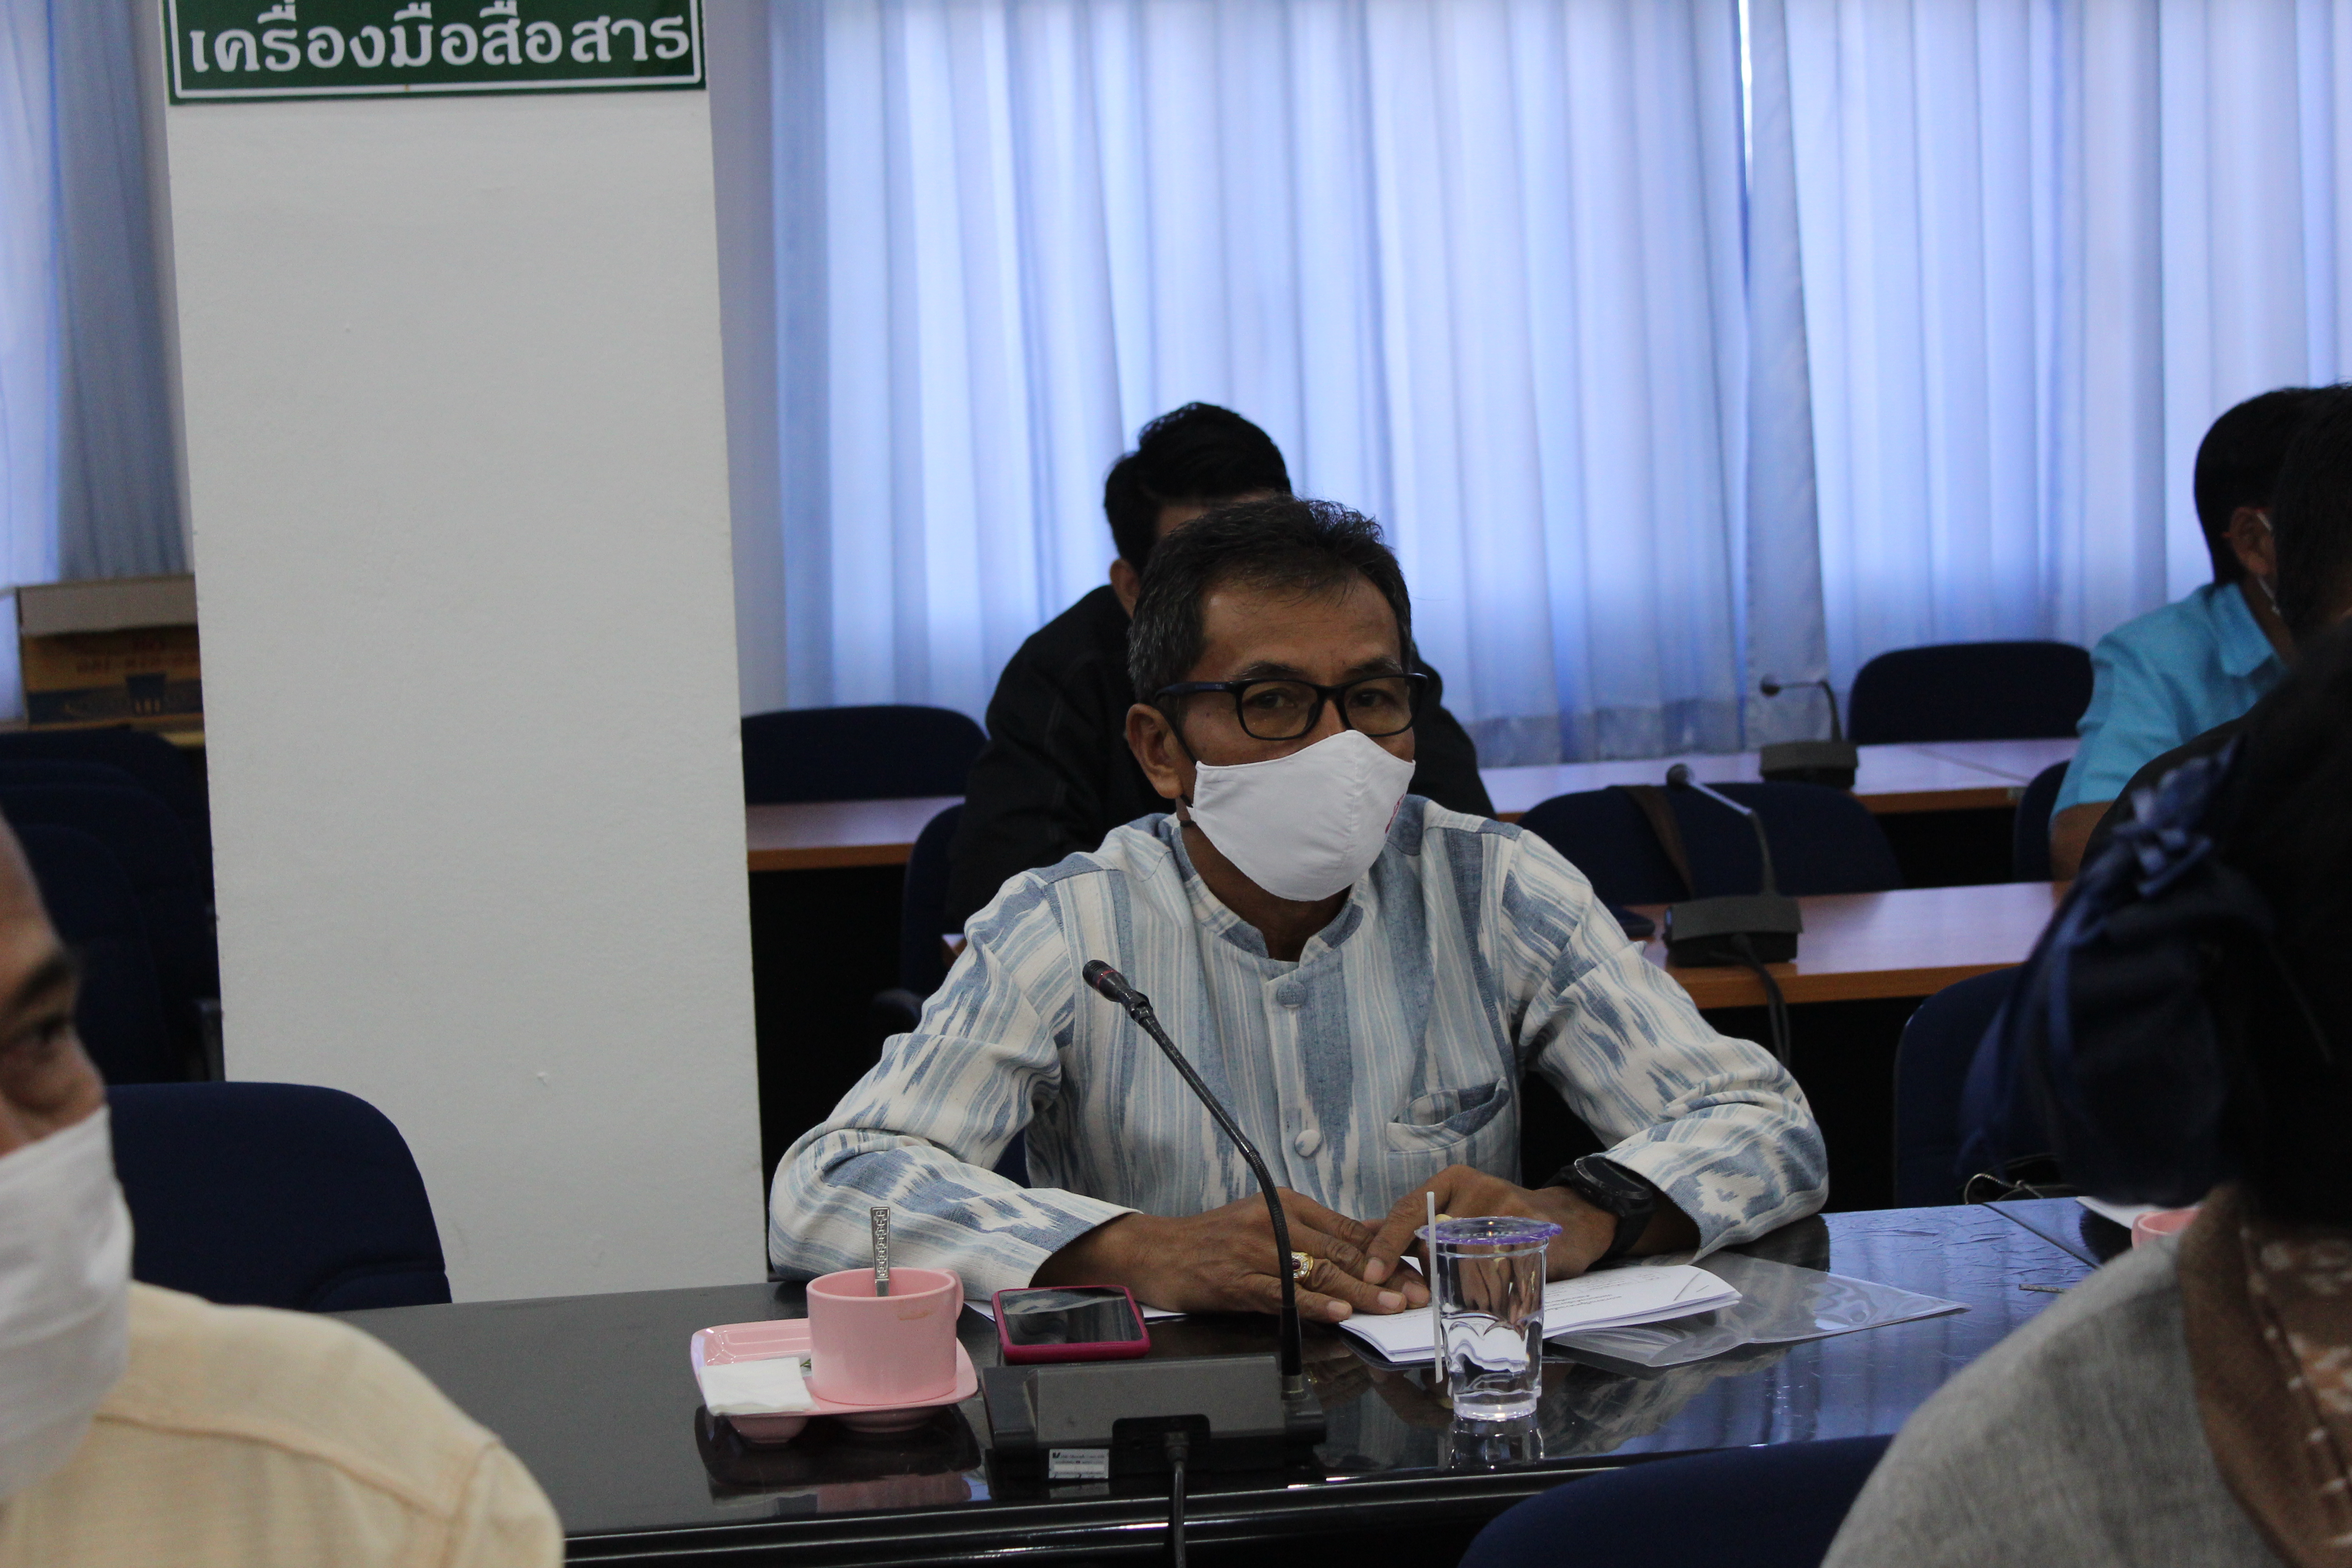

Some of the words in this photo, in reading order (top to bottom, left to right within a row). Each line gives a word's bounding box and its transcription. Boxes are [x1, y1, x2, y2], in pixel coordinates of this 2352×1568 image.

[190, 0, 689, 73] เครืองมือสือสาร
